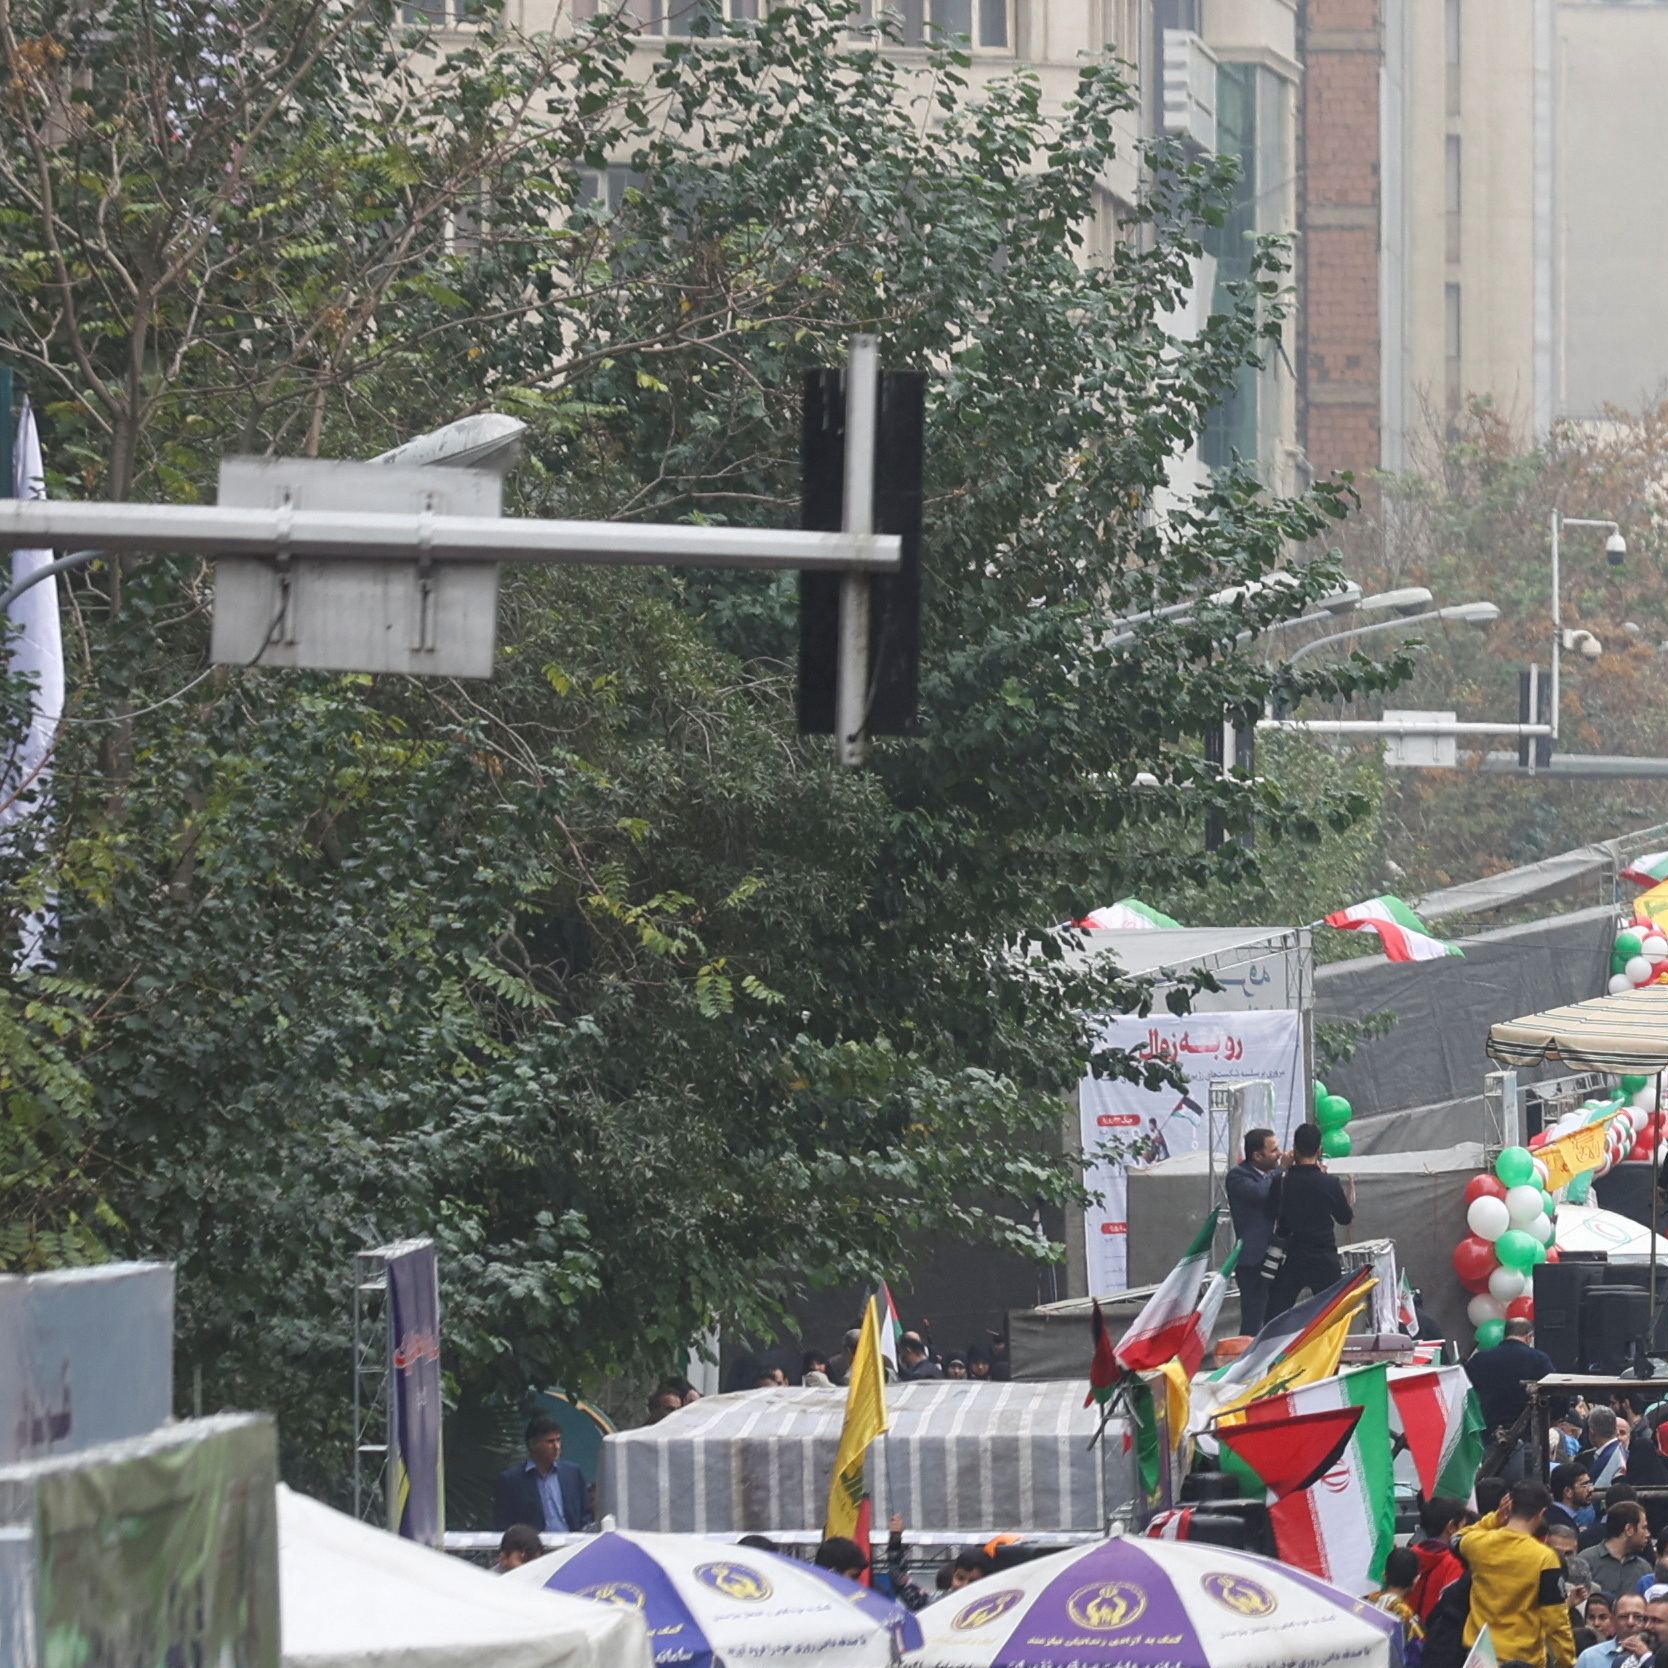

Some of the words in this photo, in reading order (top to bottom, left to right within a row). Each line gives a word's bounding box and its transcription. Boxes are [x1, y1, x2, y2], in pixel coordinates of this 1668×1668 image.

[1180, 1030, 1221, 1061] به
[1027, 1634, 1064, 1647] نیازمند
[1108, 1634, 1143, 1647] آزادی
[1144, 1636, 1156, 1646] به
[1156, 1633, 1185, 1645] کمک
